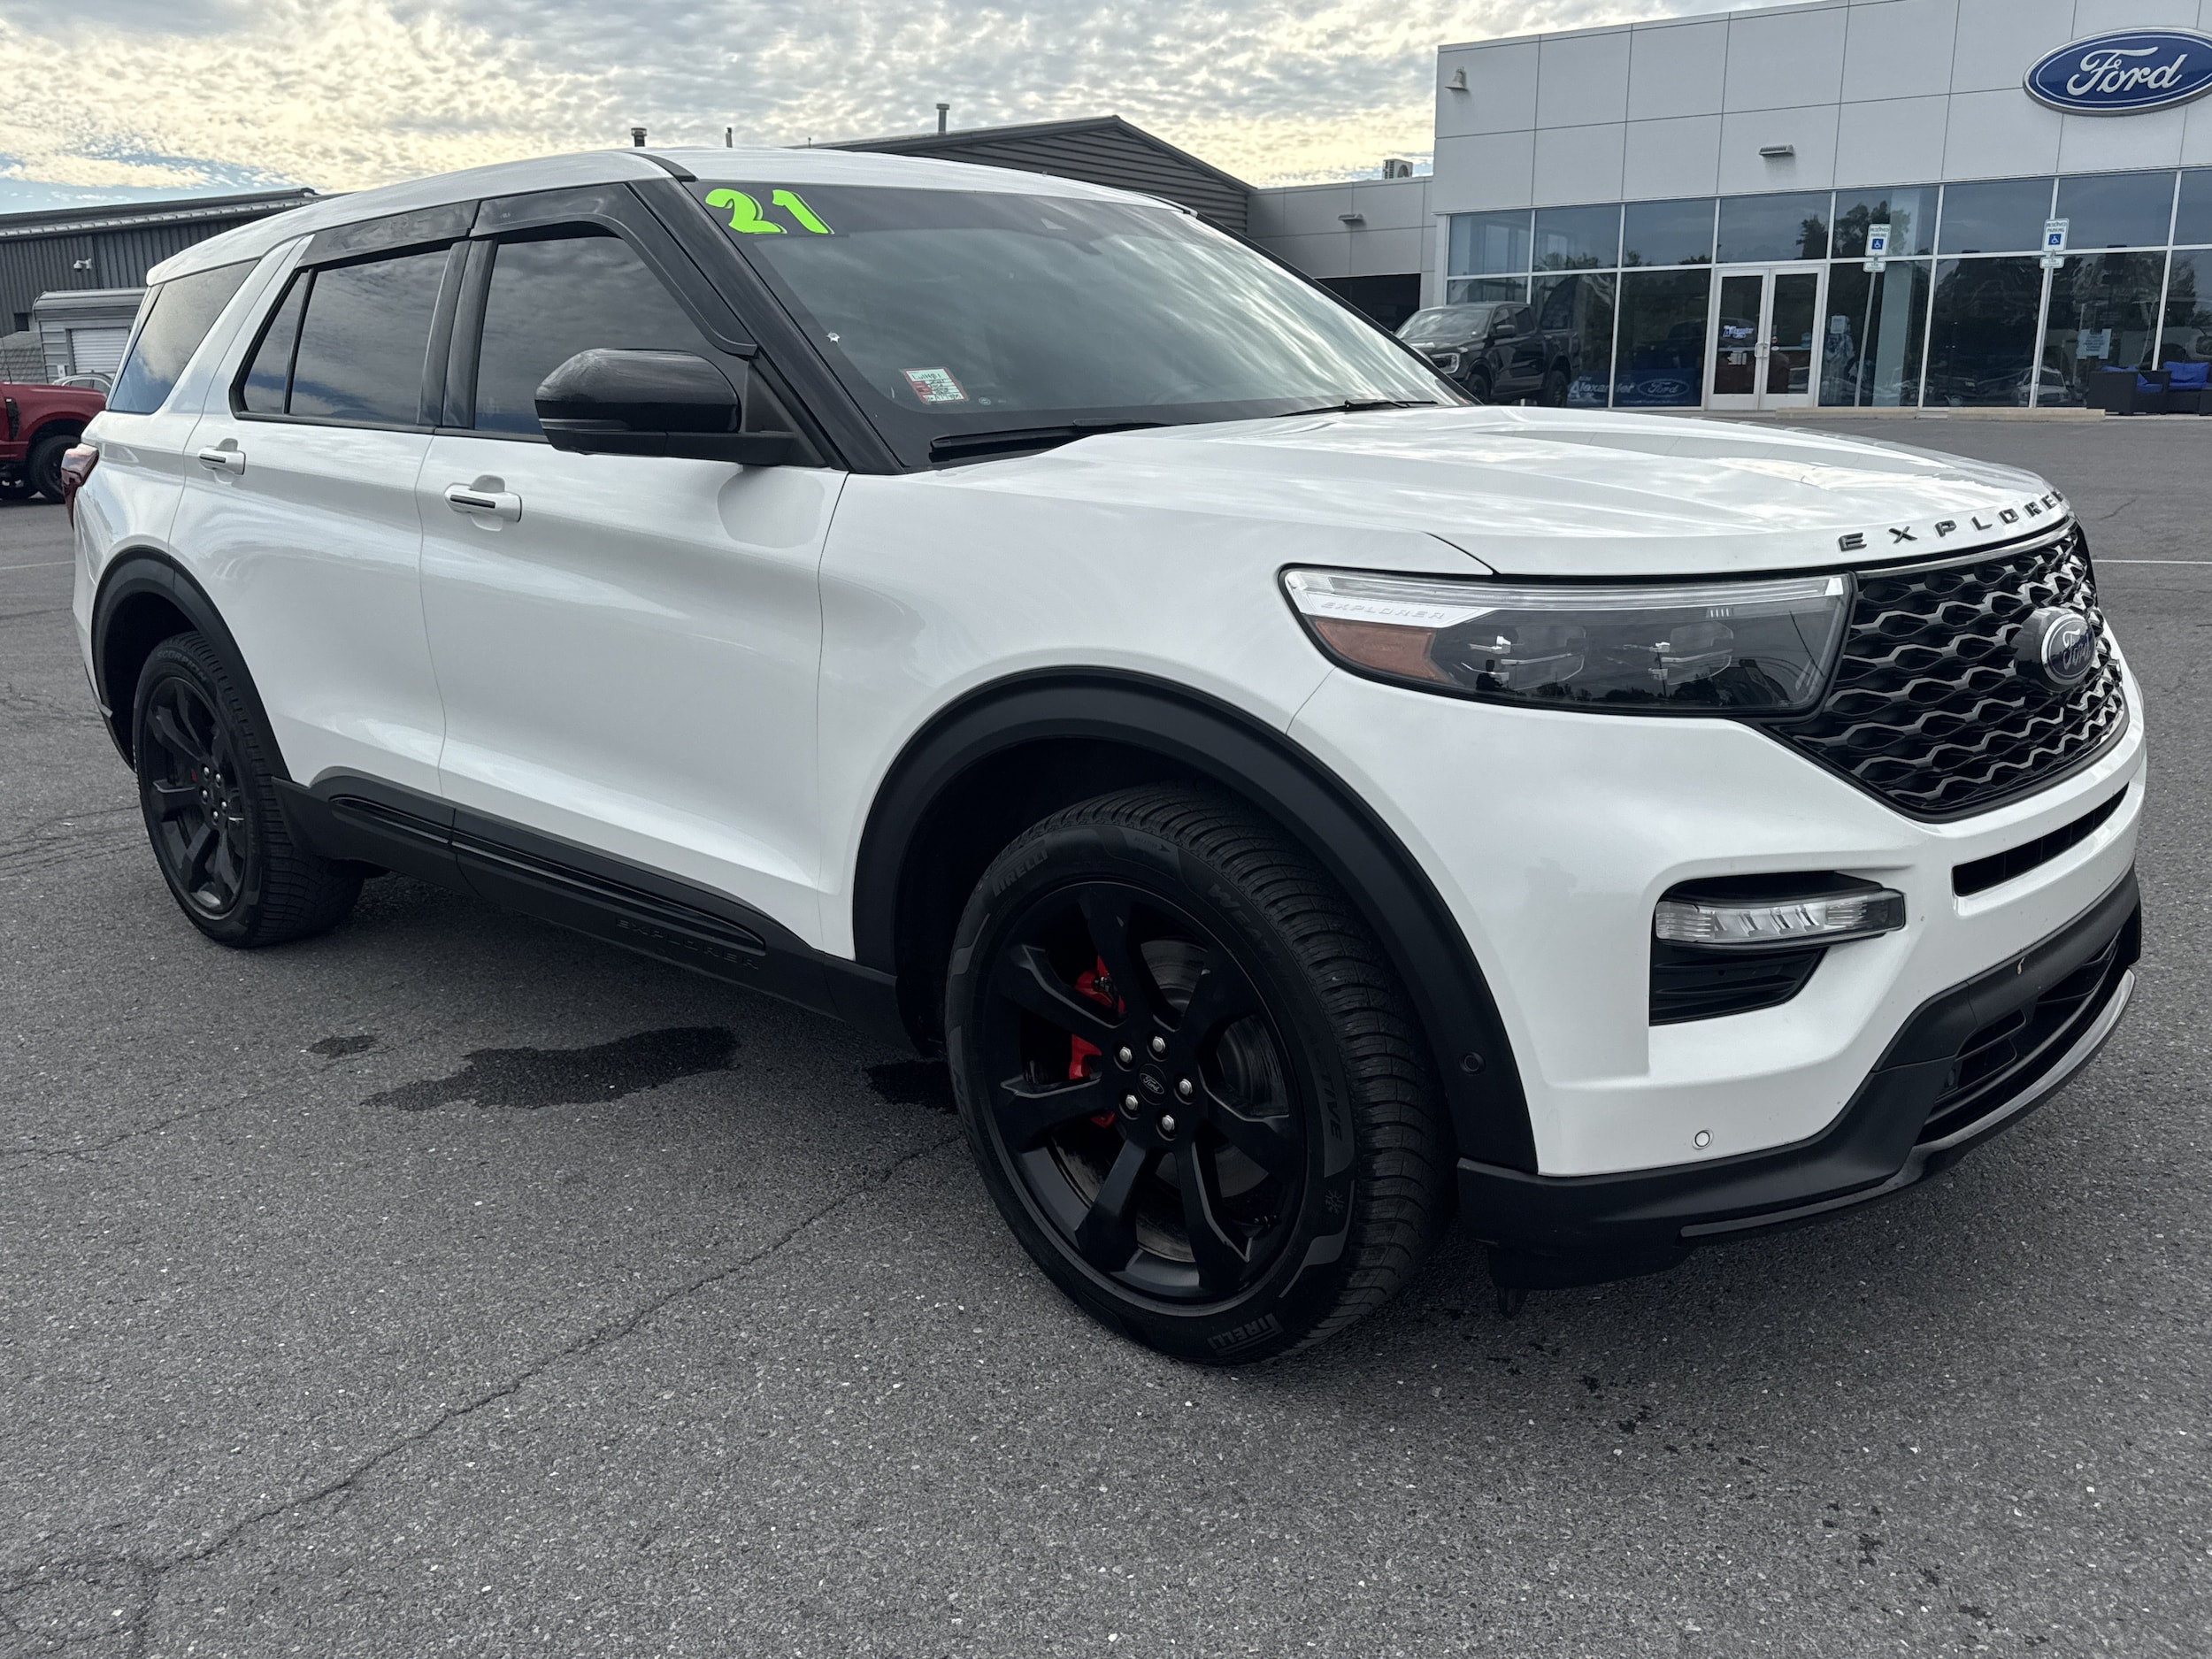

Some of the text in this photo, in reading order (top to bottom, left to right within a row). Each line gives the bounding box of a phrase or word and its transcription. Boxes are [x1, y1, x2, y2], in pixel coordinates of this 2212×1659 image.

[2066, 46, 2188, 96] Ford
[705, 188, 833, 234] 21
[1647, 381, 1679, 394] Ford
[1321, 602, 1445, 619] EXPLORER
[2062, 628, 2092, 671] Ford
[1143, 1076, 1160, 1092] Ford
